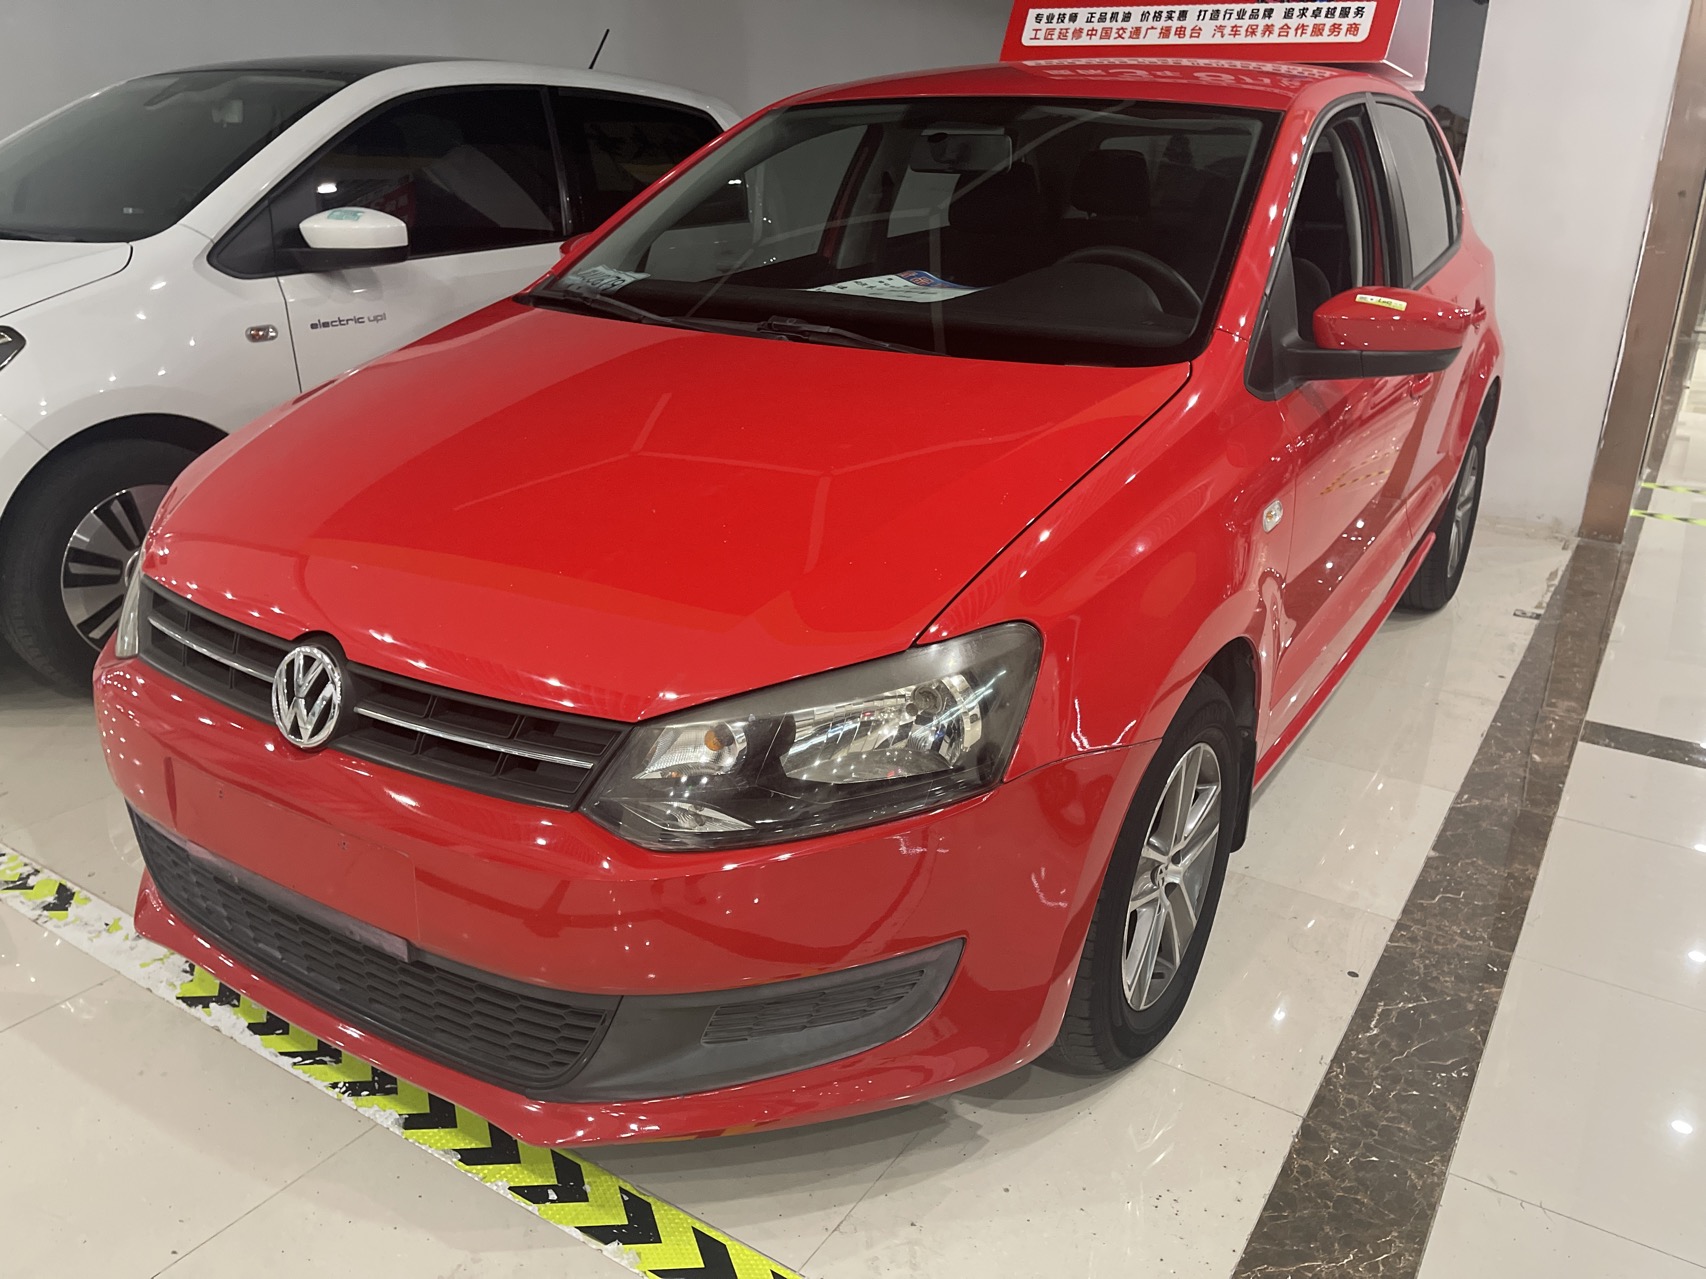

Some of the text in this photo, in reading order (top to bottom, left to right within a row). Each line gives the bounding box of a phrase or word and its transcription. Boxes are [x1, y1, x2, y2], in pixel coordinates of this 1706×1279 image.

[1034, 6, 1366, 24] 专业技师 正品机油 价格实惠 打造行业品牌 追求卓越服务
[1211, 22, 1362, 38] 汽车保养合作服务商
[310, 316, 366, 330] electric
